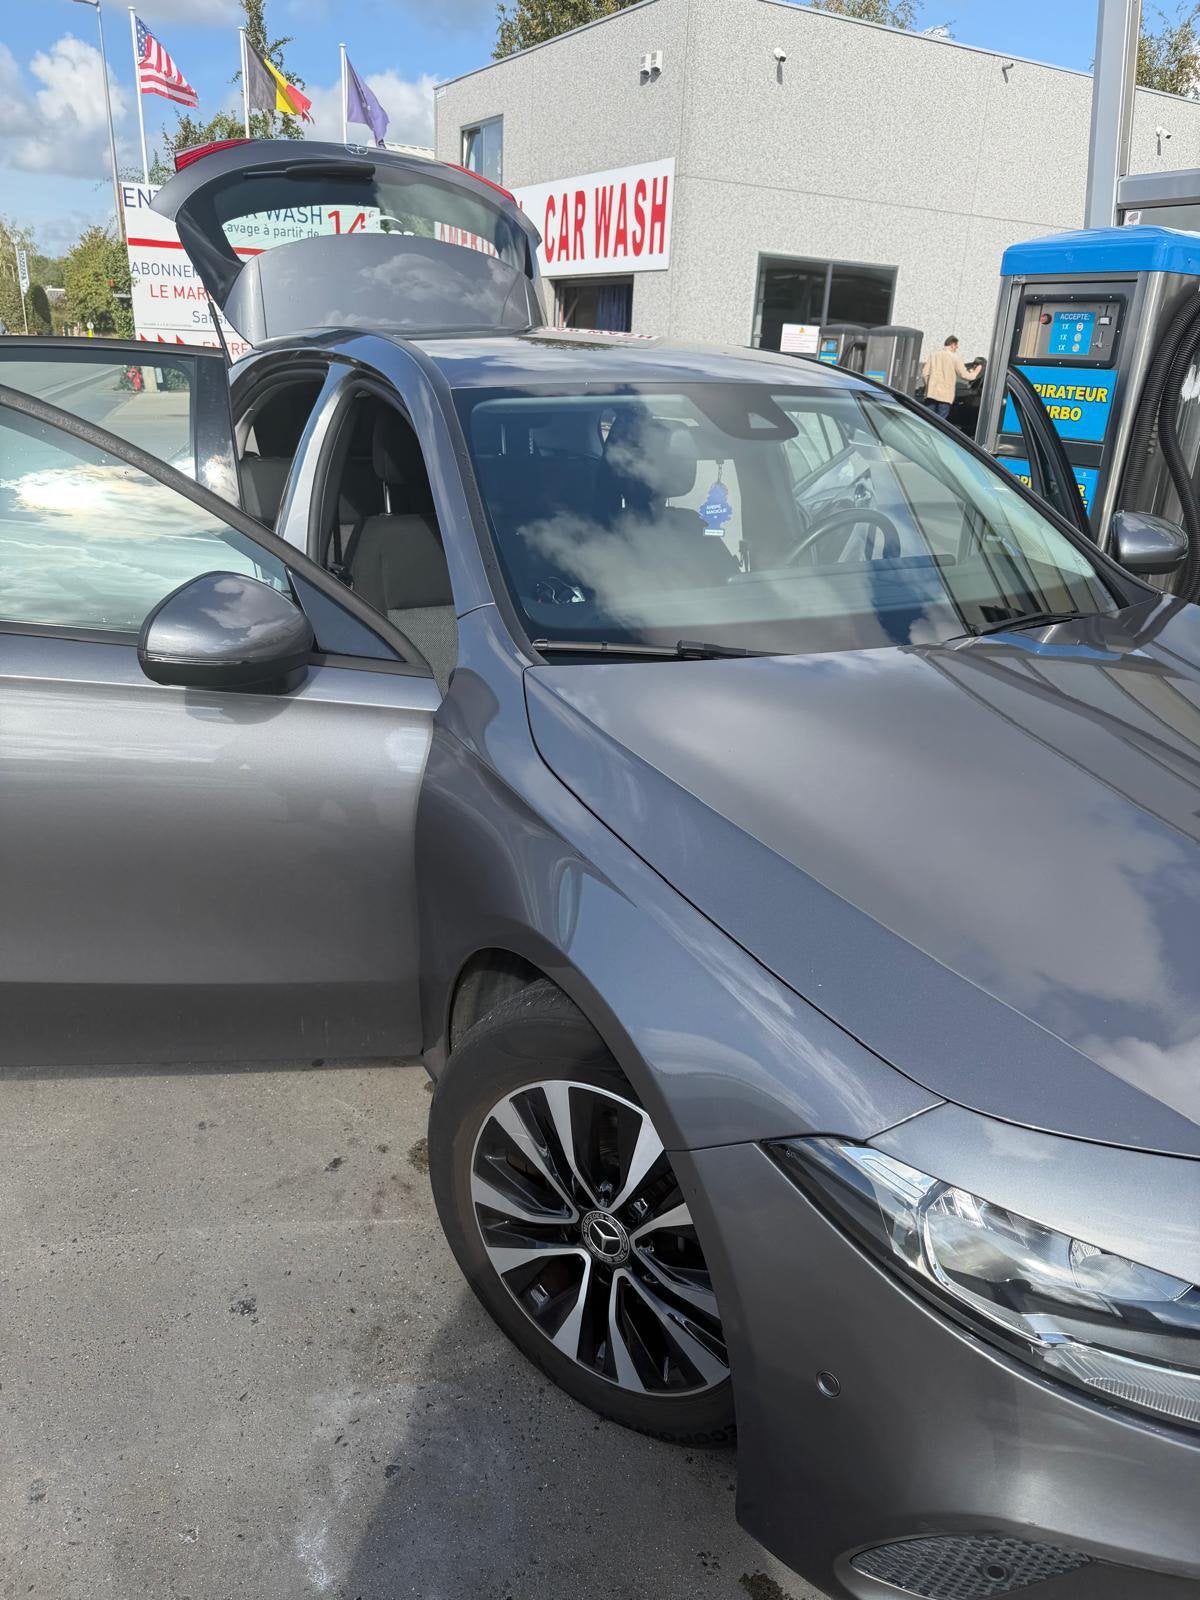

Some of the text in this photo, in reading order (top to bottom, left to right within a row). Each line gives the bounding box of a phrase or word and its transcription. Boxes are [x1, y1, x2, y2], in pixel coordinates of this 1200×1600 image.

[544, 175, 668, 263] CAR WASH
[224, 223, 263, 237] avage
[273, 227, 304, 239] partir
[150, 284, 215, 301] LE MAR
